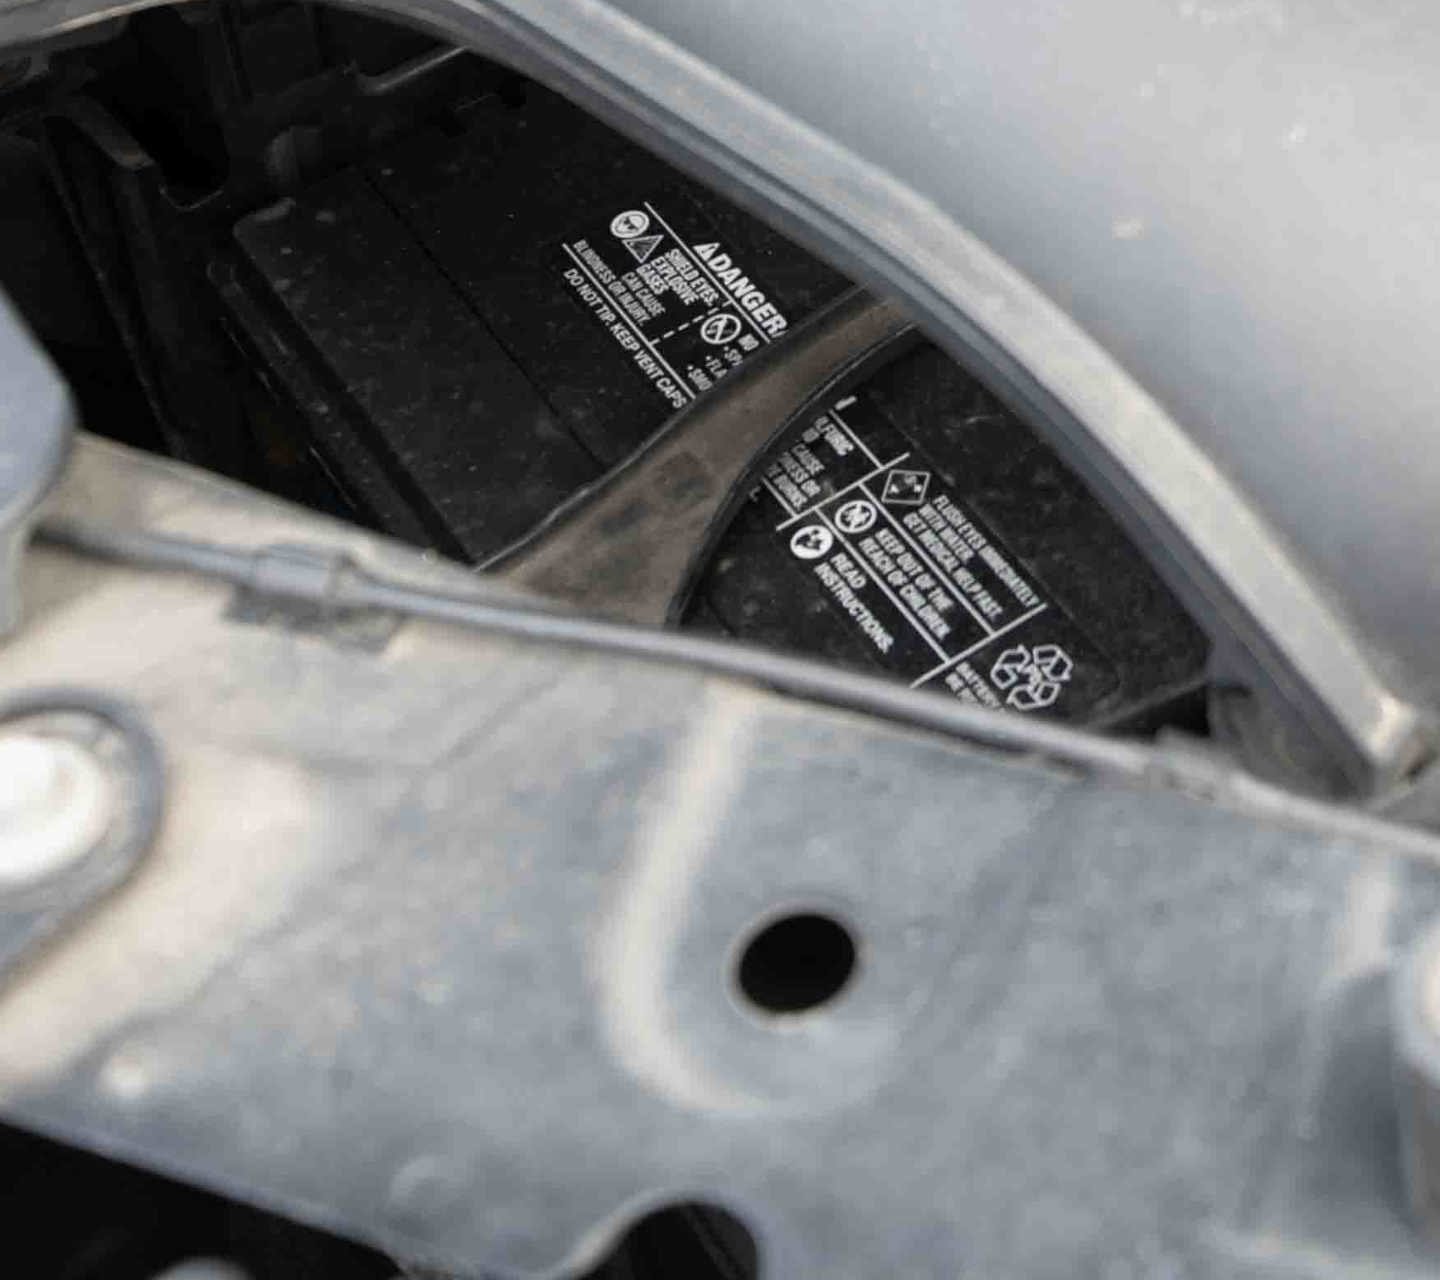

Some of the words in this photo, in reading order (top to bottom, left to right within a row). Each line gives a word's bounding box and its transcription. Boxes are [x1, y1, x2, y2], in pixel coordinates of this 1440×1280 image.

[572, 238, 617, 284] BLINDNESS
[606, 279, 627, 296] OR
[634, 262, 670, 295] GASES
[649, 255, 700, 305] EXPLOSIVE
[663, 247, 700, 282] SHIELD
[620, 270, 645, 291] CAN
[634, 287, 666, 317] CAUSE
[561, 267, 586, 287] DO
[575, 282, 604, 308] NOT
[607, 321, 642, 353] KEEP
[631, 348, 665, 381] VENT
[653, 375, 689, 409] CAPS
[916, 502, 948, 532] WITH
[828, 551, 869, 591] READ
[856, 535, 897, 575] REACH
[884, 568, 909, 589] OF
[873, 526, 907, 557] KEEP
[893, 550, 925, 578] OUT
[912, 571, 937, 593] OF
[925, 585, 955, 613] THE
[900, 510, 928, 535] GET
[916, 527, 962, 573] MEDICAL
[950, 566, 983, 596] HELP
[931, 493, 968, 528] FLUSH
[956, 521, 988, 550] EYES
[976, 543, 1040, 609] IMMEDIATELY
